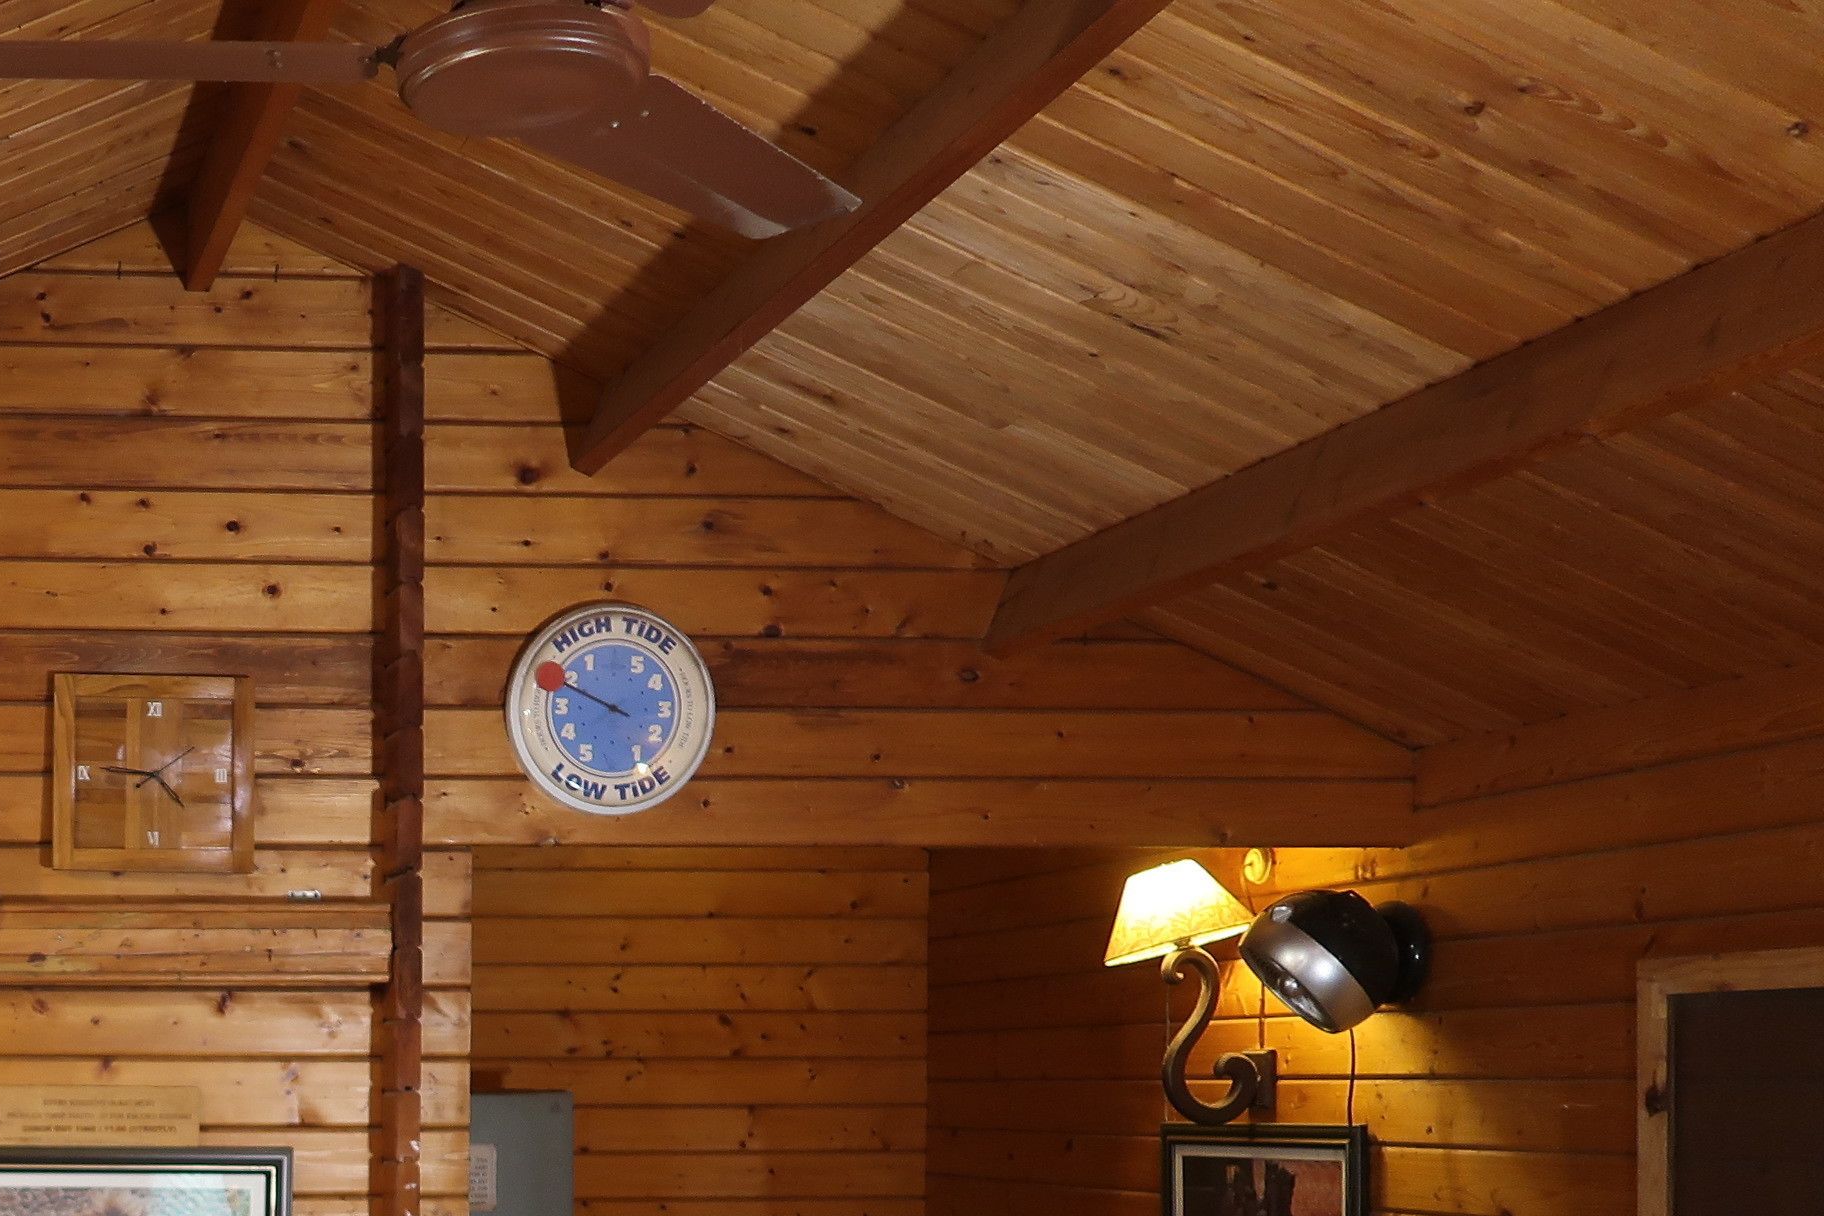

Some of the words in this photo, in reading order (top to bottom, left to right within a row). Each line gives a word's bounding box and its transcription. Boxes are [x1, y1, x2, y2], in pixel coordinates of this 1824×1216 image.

[552, 617, 612, 653] HIGH
[584, 654, 595, 671] 1
[630, 656, 645, 673] 5
[564, 671, 578, 687] 2
[647, 674, 663, 691] 4
[555, 698, 568, 715] 3
[657, 701, 672, 718] 3
[561, 723, 576, 740] 4
[647, 724, 663, 743] 2
[578, 744, 593, 762] 5
[631, 745, 642, 762] 1
[550, 763, 606, 800] LOW
